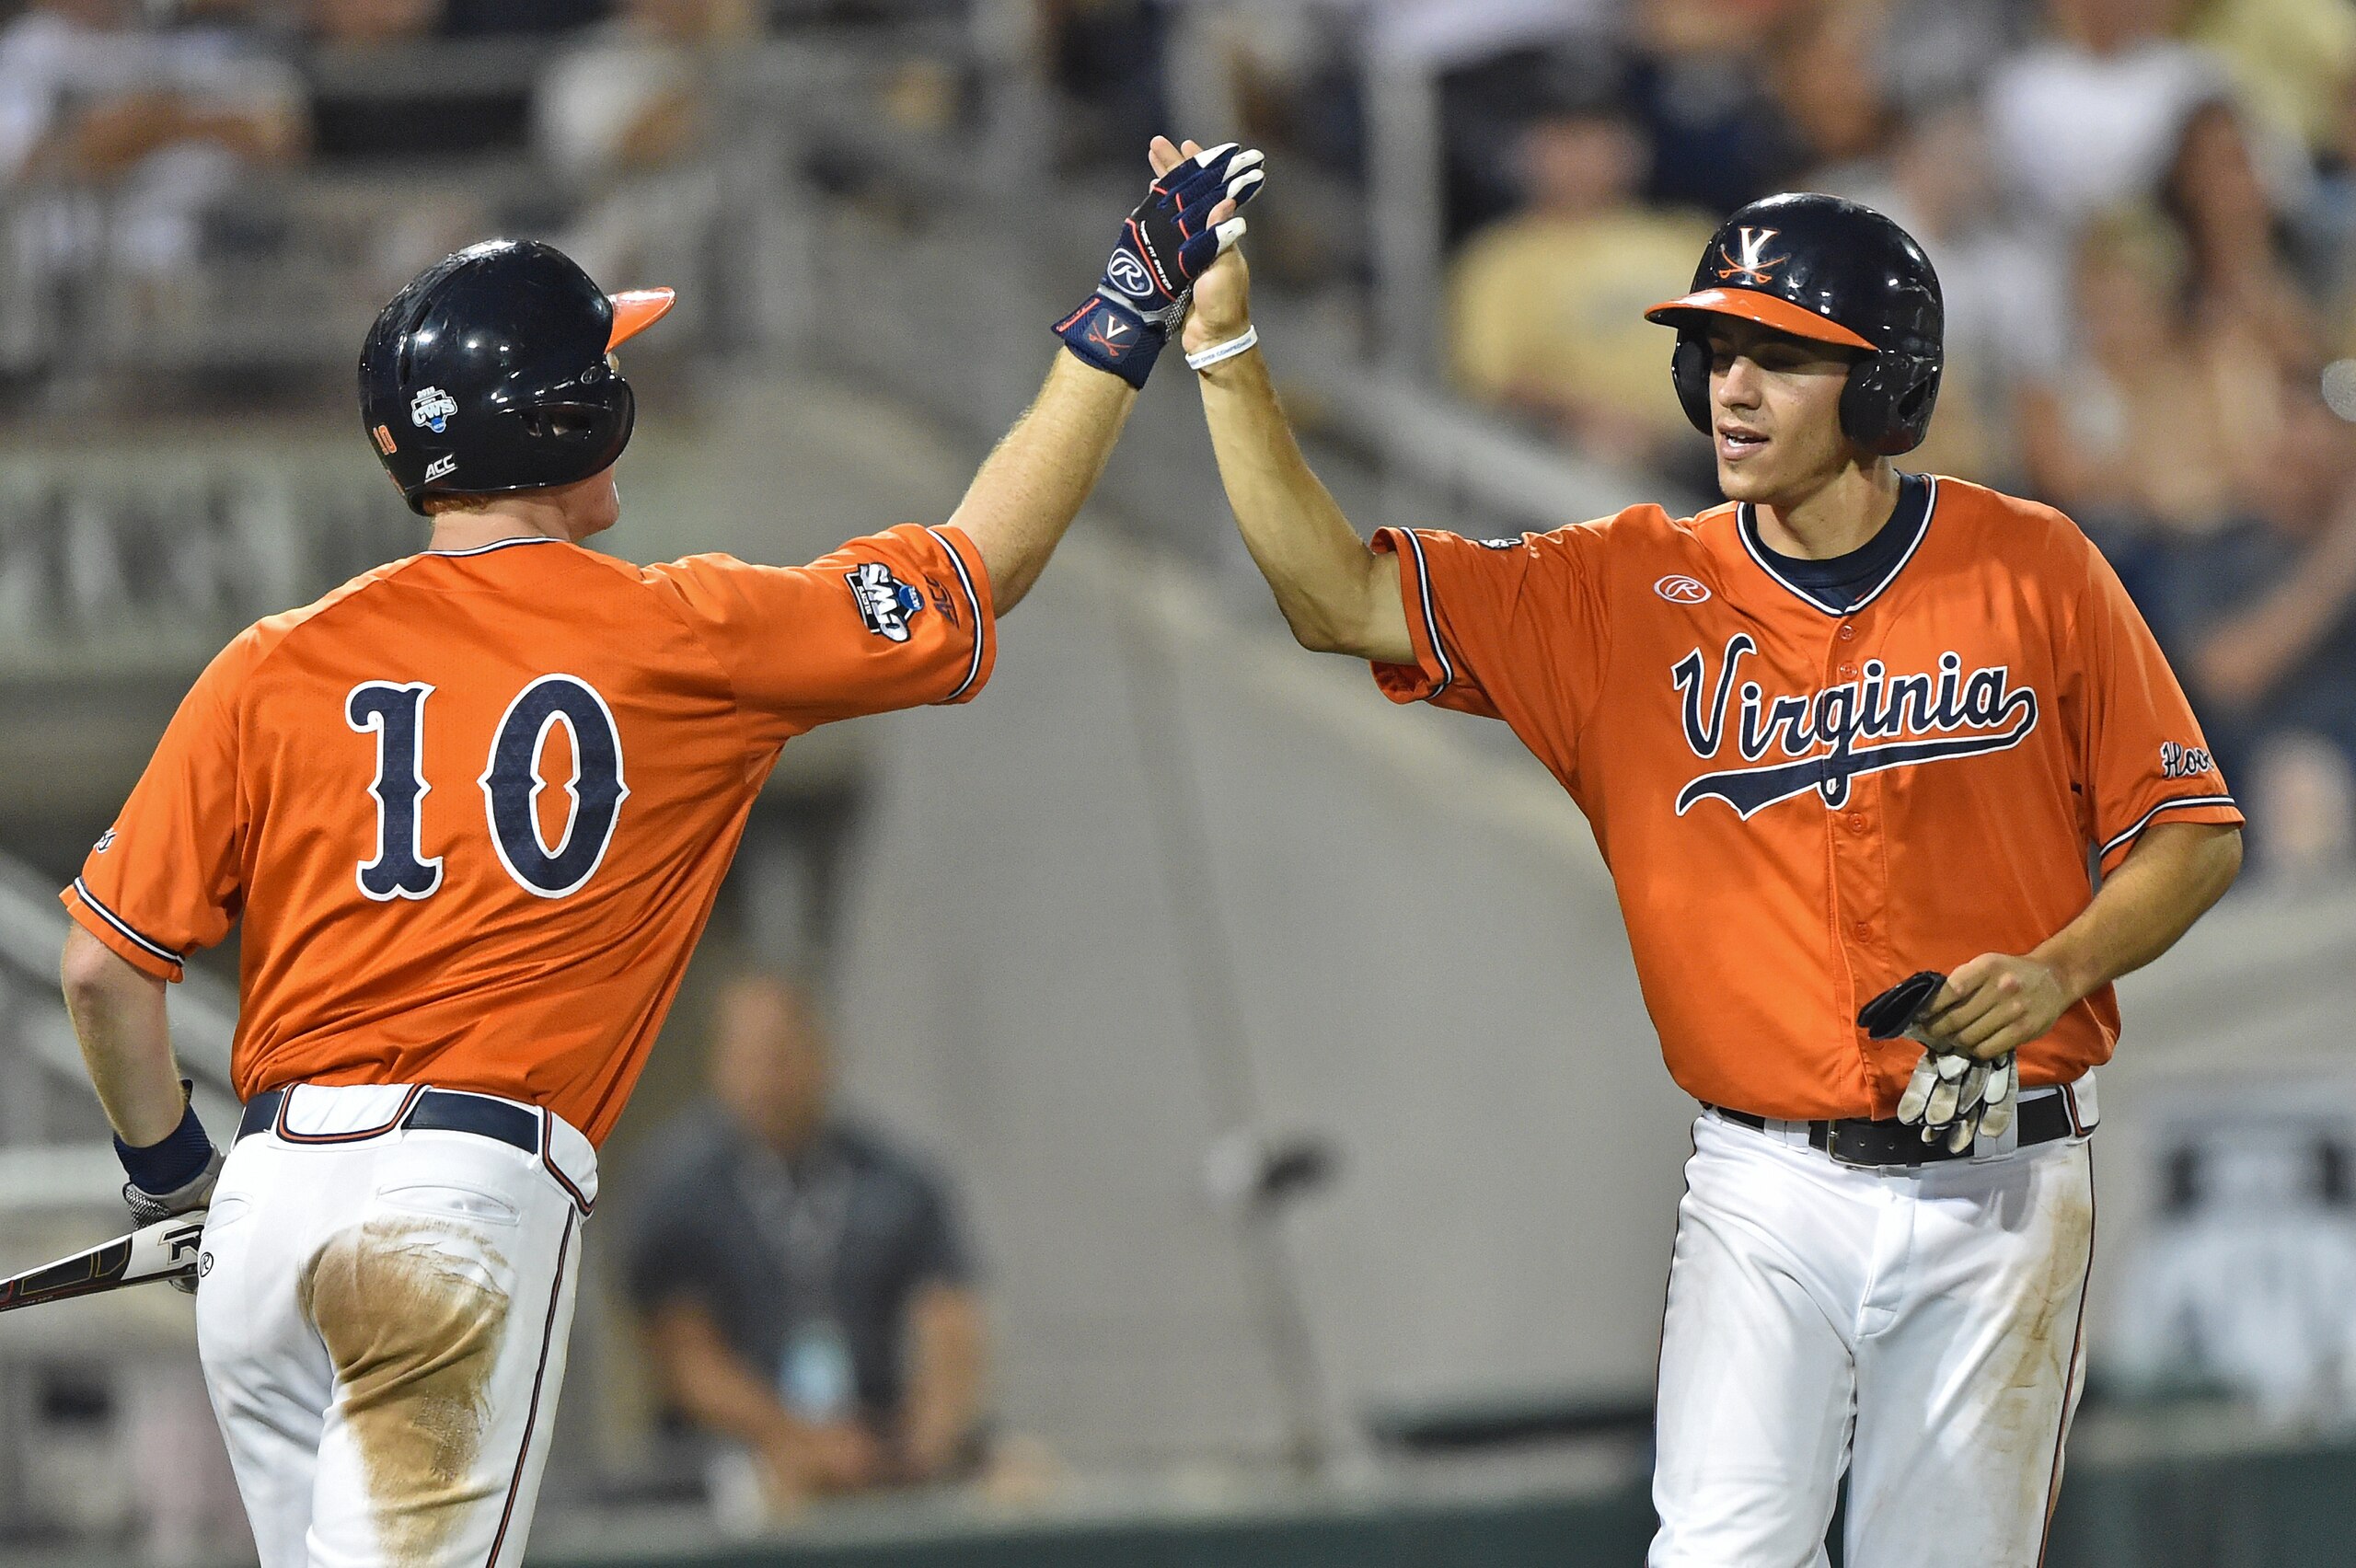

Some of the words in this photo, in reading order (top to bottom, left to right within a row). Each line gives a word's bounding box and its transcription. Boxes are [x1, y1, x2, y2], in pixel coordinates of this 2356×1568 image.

[1738, 226, 1779, 270] V
[1106, 315, 1129, 341] V
[413, 398, 456, 425] CWS
[373, 424, 398, 455] 10
[425, 454, 458, 481] ACC
[860, 563, 908, 641] CWS
[1670, 632, 2038, 817] Virginia
[345, 673, 630, 901] 10
